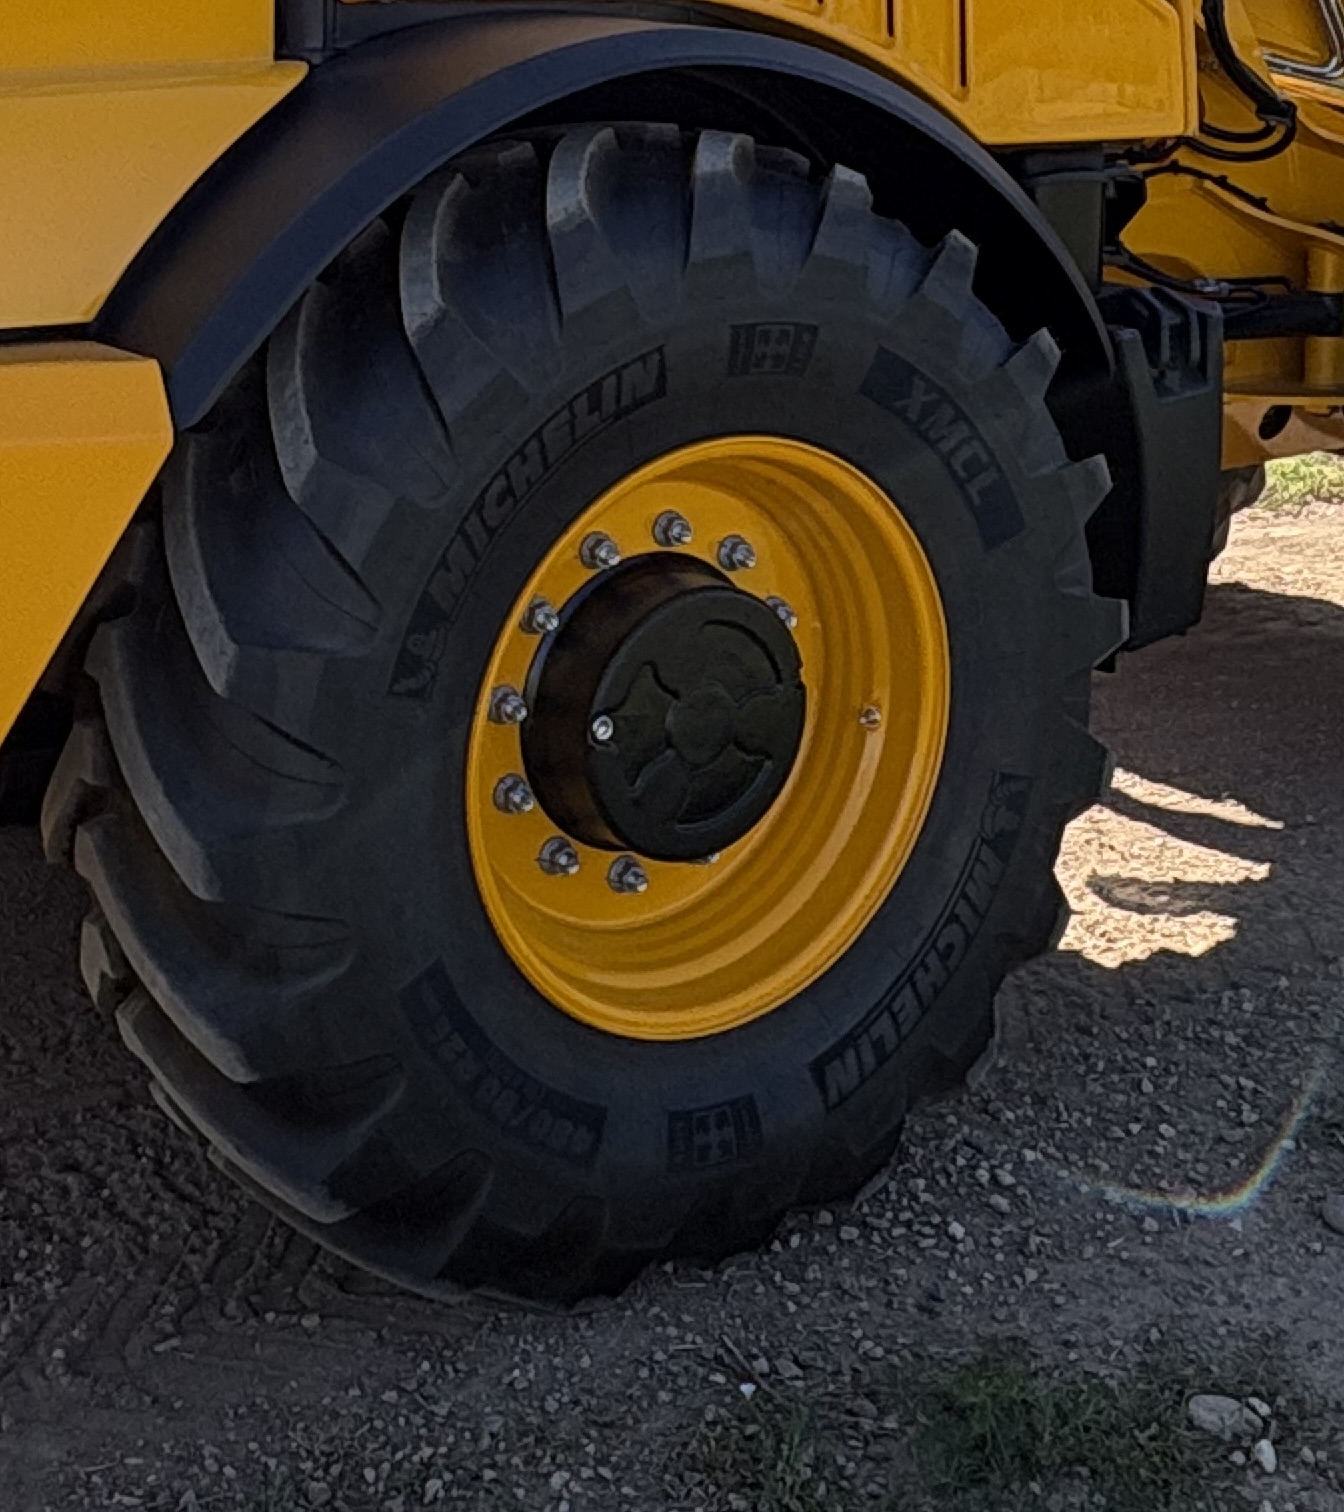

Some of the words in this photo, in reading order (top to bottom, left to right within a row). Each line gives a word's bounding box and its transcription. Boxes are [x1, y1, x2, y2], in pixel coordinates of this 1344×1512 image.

[429, 349, 663, 614] MICHELIN
[895, 374, 999, 506] XMCL
[820, 848, 1001, 1107] MICHELIN
